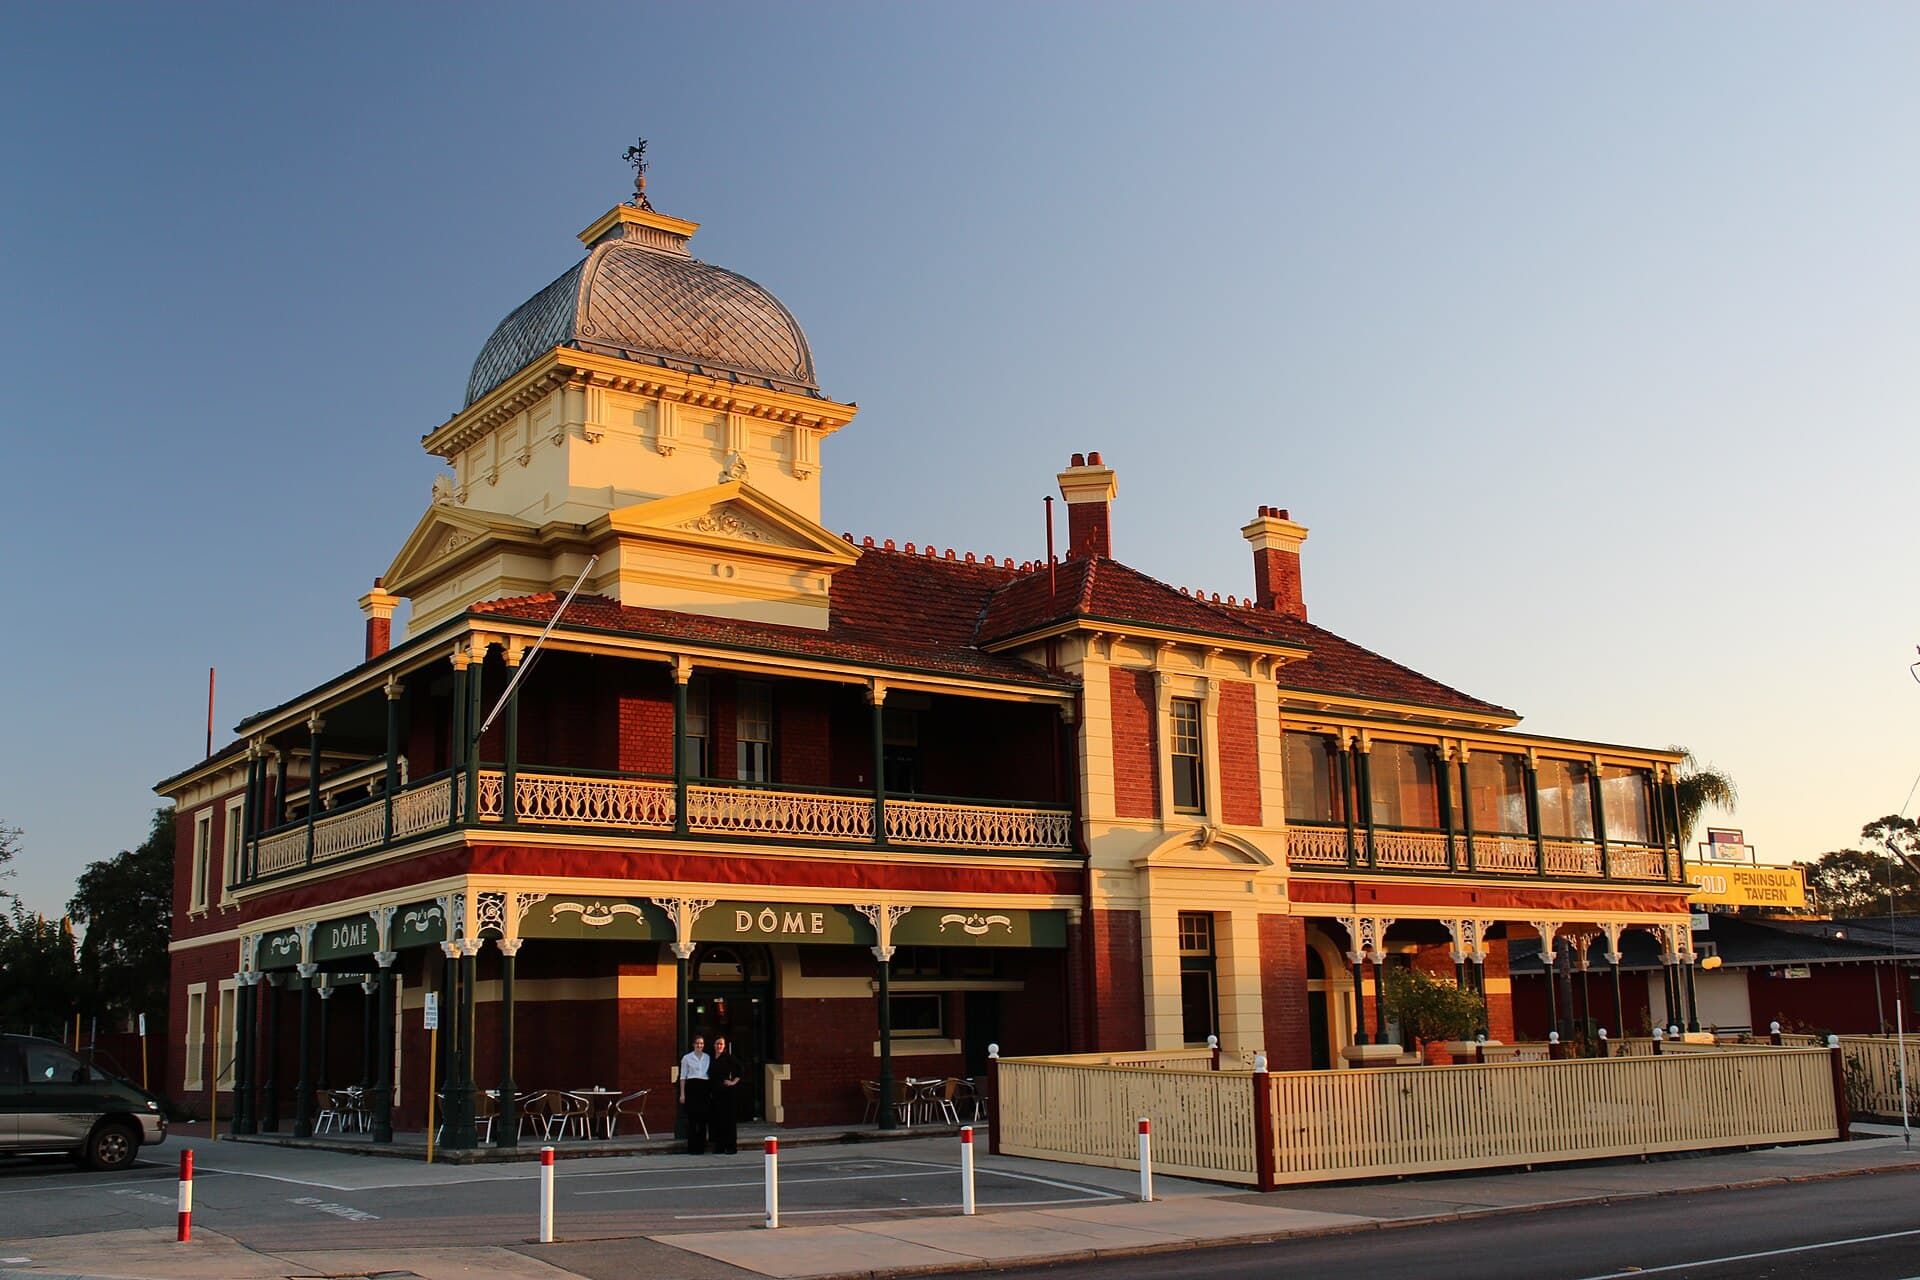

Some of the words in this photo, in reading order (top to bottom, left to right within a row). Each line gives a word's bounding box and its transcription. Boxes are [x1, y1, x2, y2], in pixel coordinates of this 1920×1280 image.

[1692, 875, 1727, 894] GOLD
[1733, 872, 1797, 887] PENINSULA
[1744, 888, 1787, 901] TAVERN
[735, 906, 824, 934] DÔME
[332, 922, 368, 949] DÔME
